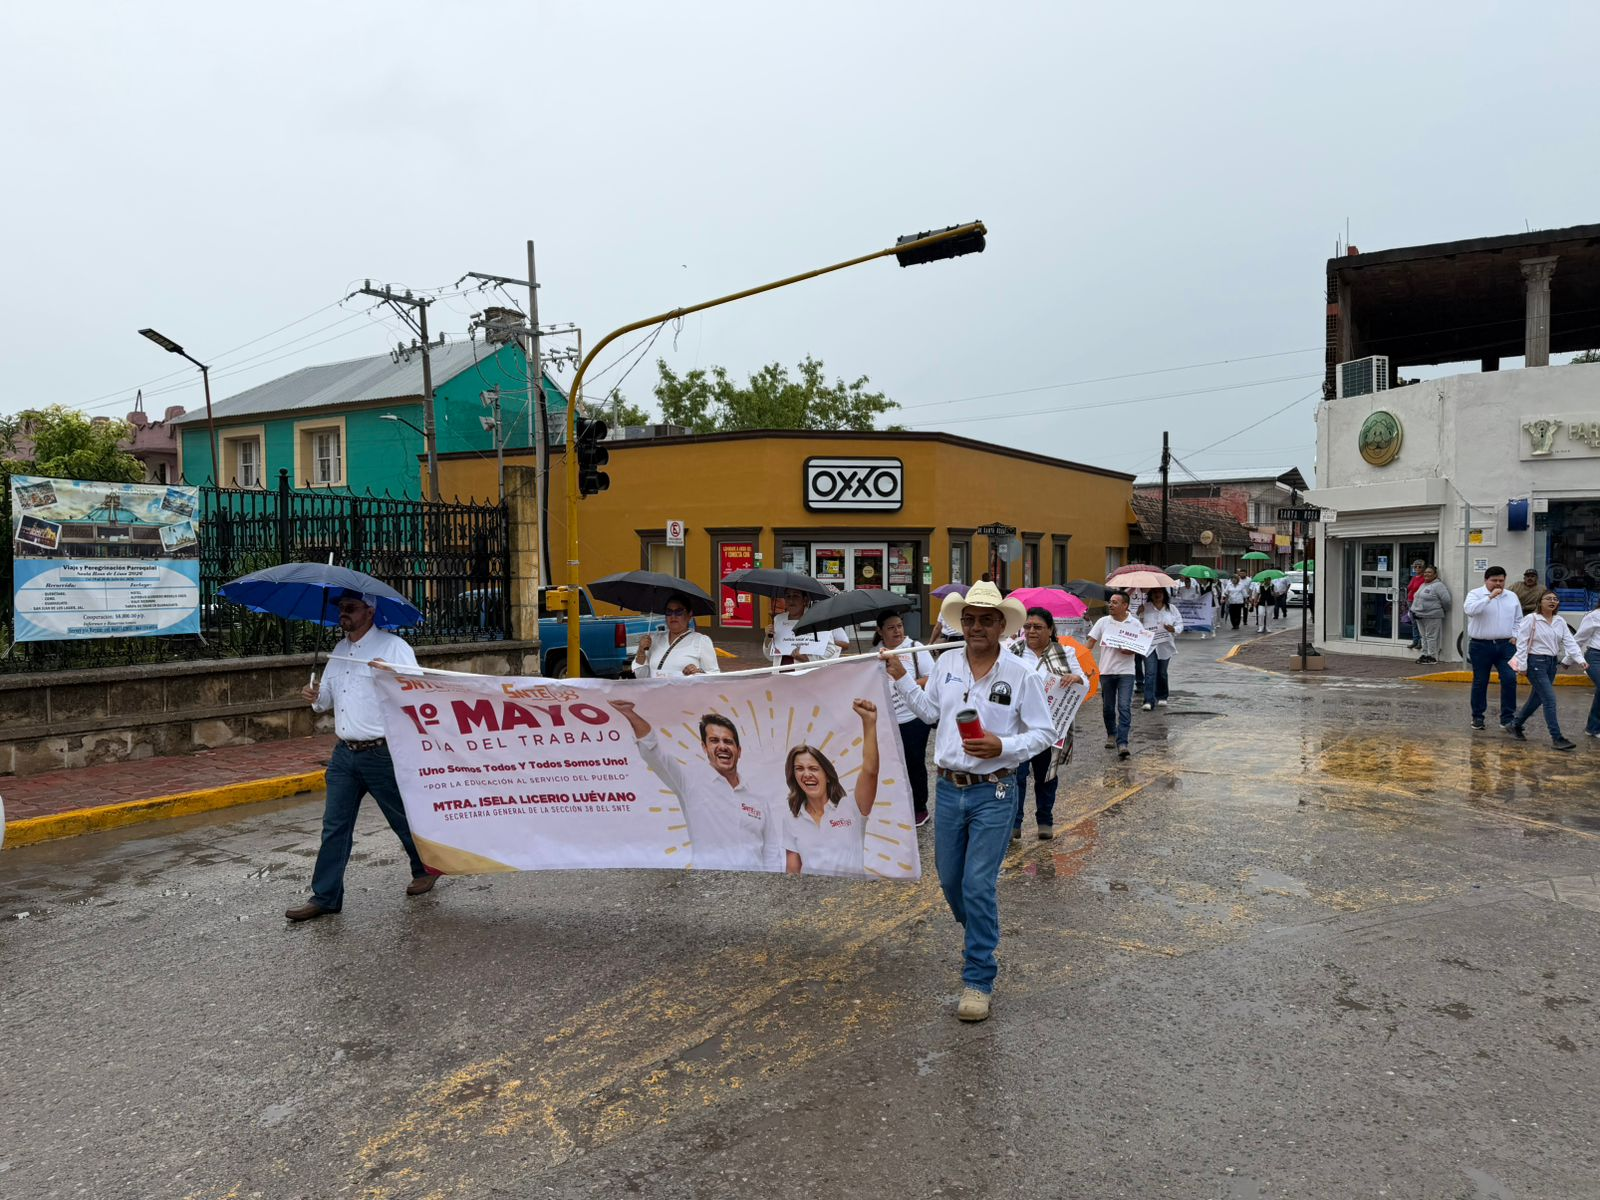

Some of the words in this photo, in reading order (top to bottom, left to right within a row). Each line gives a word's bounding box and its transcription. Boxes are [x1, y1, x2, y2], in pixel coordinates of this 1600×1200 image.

[812, 468, 899, 500] OXXO
[84, 564, 125, 572] Peregrinación
[451, 699, 610, 735] MAYO
[467, 737, 507, 751] DEL
[518, 729, 620, 747] TRABAJO
[418, 767, 446, 777] ¡Uno
[447, 764, 482, 773] Somos
[483, 763, 517, 772] Todos
[518, 761, 526, 770] Y
[529, 760, 562, 769] Todos
[564, 759, 601, 768] Somos
[602, 757, 629, 766] Uno!
[450, 780, 462, 788] LA
[464, 777, 514, 787] EDUCACIÓN
[530, 775, 570, 784] SERVICIO
[573, 774, 589, 782] DEL
[433, 798, 477, 812] MTRA.
[479, 795, 518, 807] ISELA
[519, 793, 570, 804] LICERIO
[572, 790, 636, 803] LUÉVANO
[444, 809, 491, 821] SECRETARIA
[493, 807, 526, 817] GENERAL
[540, 806, 549, 814] LA
[551, 804, 582, 814] SECCIÓN
[596, 804, 610, 812] DEL
[612, 804, 631, 812] SNTE
